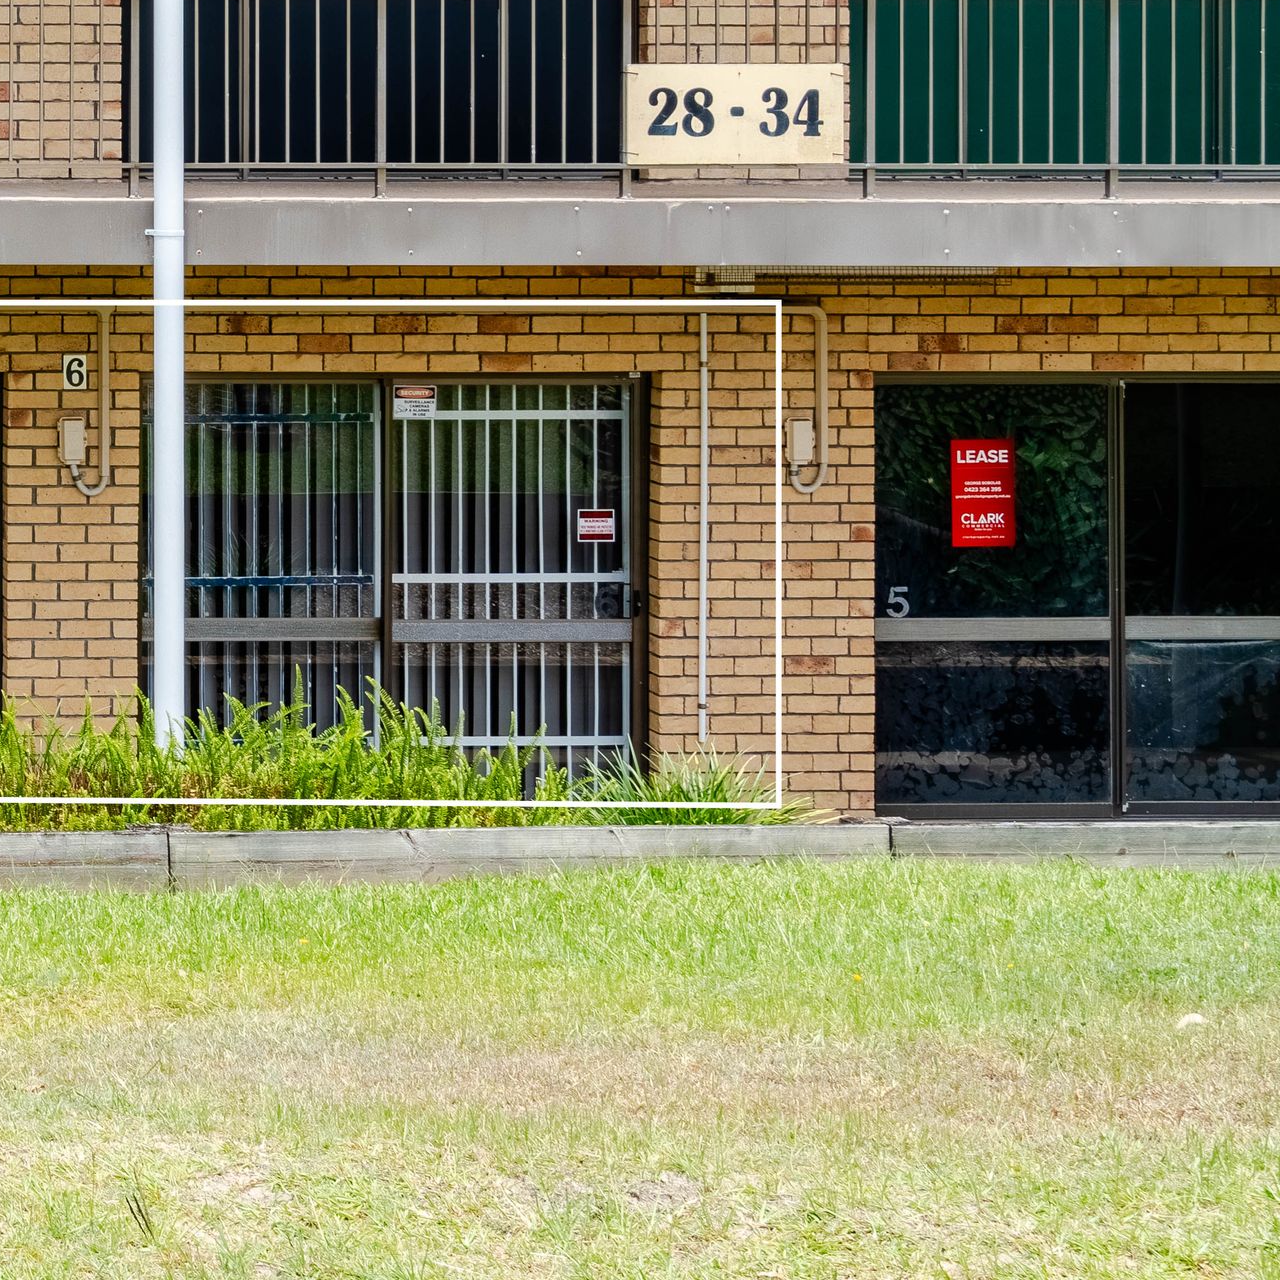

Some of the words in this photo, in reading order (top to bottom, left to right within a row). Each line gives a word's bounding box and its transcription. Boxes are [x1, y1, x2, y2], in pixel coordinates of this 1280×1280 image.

[648, 87, 715, 137] 28
[759, 87, 824, 137] 34
[66, 358, 84, 387] 6
[956, 450, 1008, 463] LEASE
[961, 513, 1005, 524] CLARK
[886, 586, 910, 618] 5
